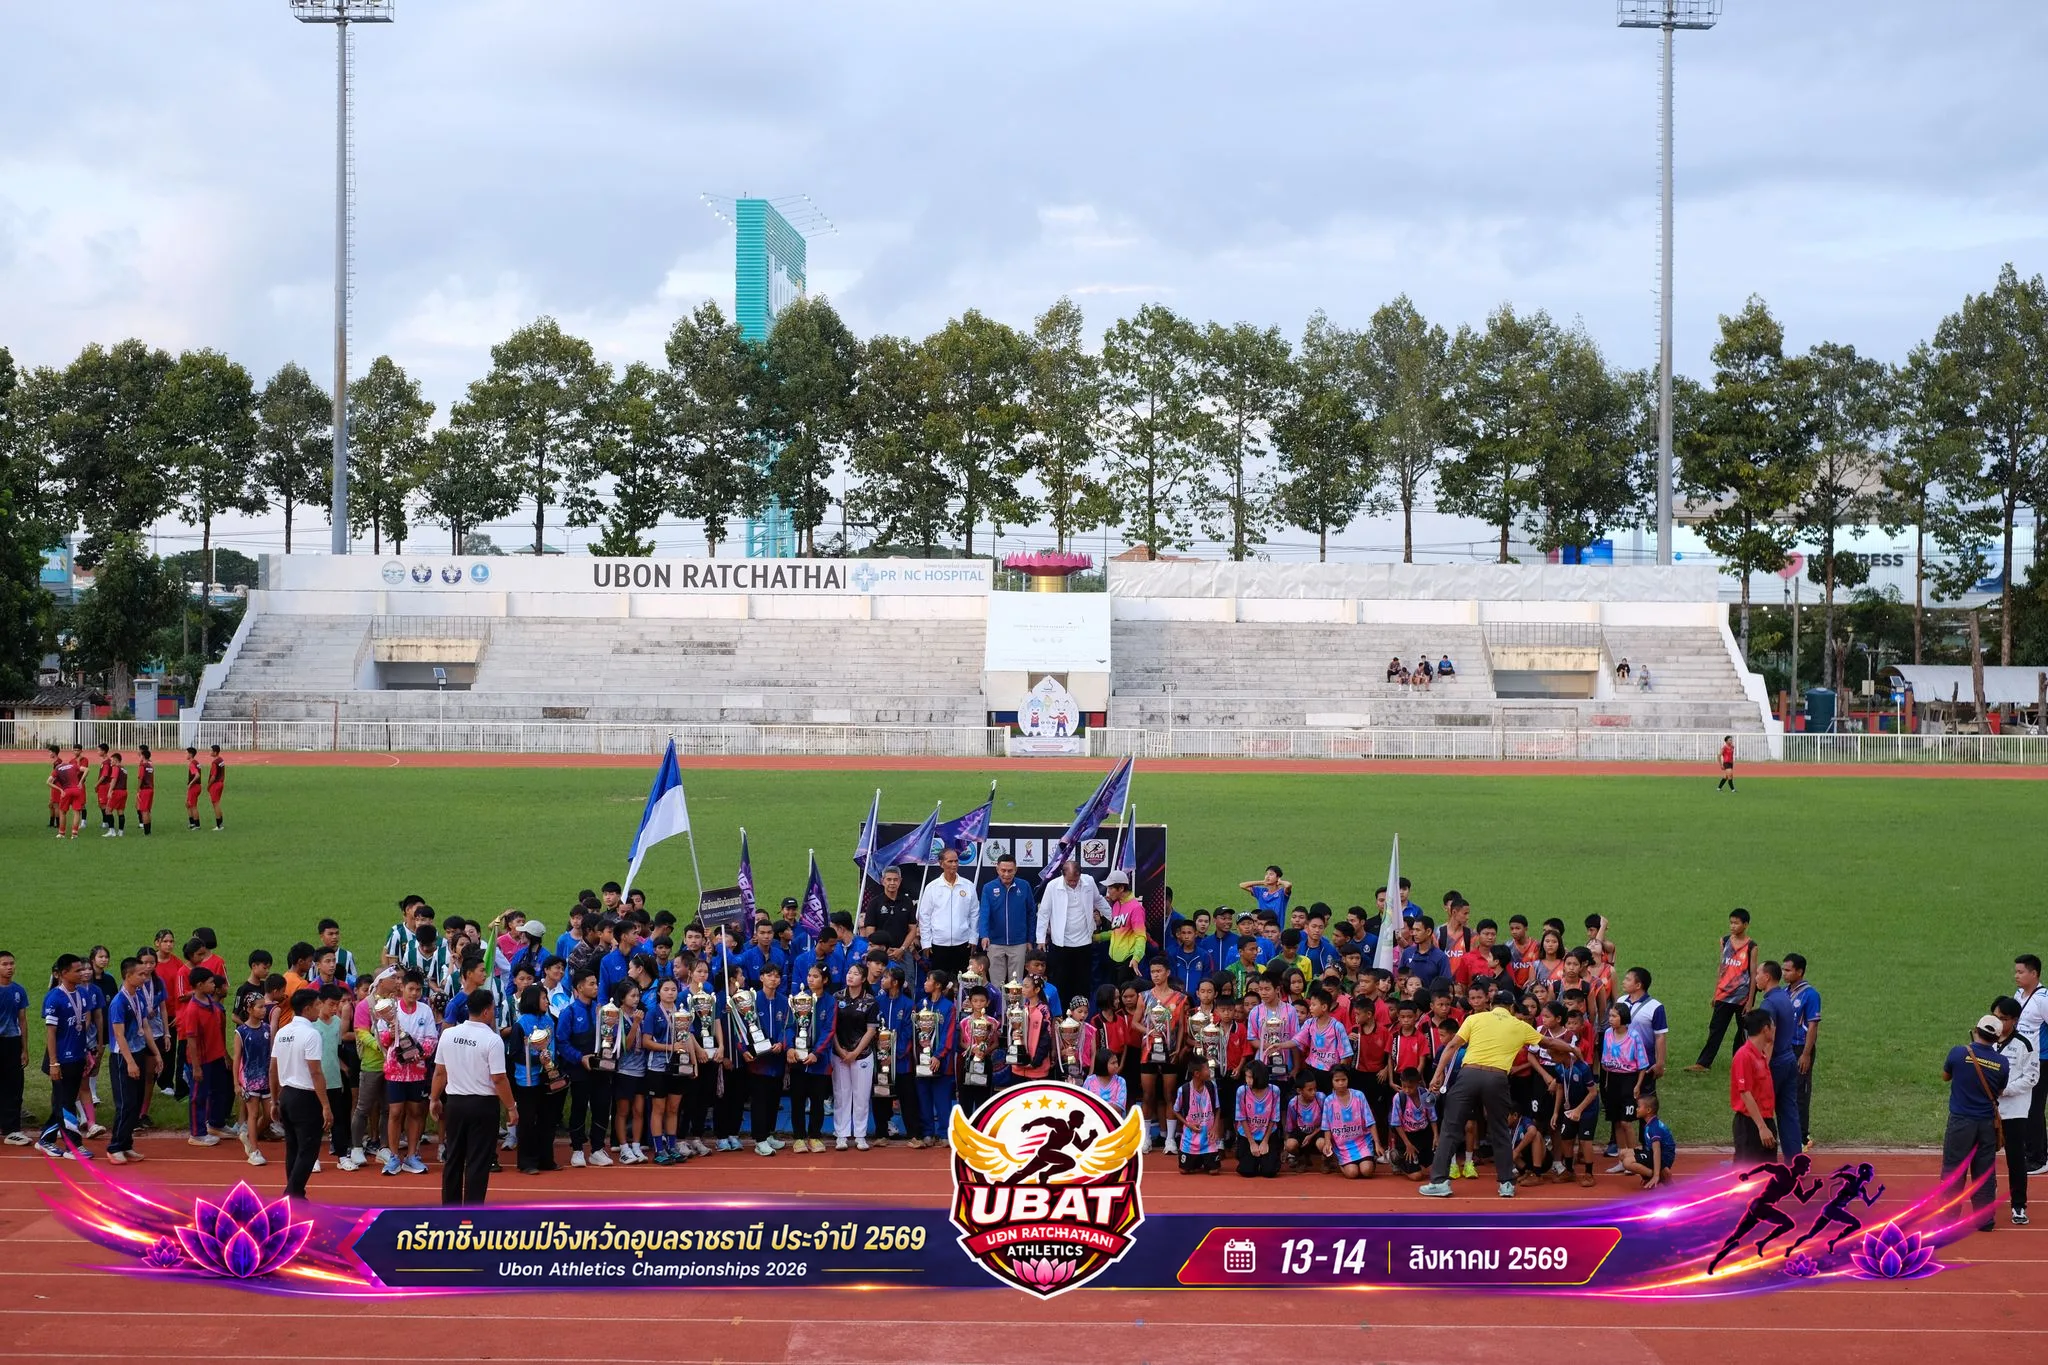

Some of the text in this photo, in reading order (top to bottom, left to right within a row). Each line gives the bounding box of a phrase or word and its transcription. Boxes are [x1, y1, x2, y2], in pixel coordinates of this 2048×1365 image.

[593, 563, 671, 588] UBON
[924, 570, 984, 581] HOSPITAL
[1725, 958, 1742, 966] KNP
[1531, 1100, 1539, 1112] 6
[1625, 1105, 1635, 1115] 10
